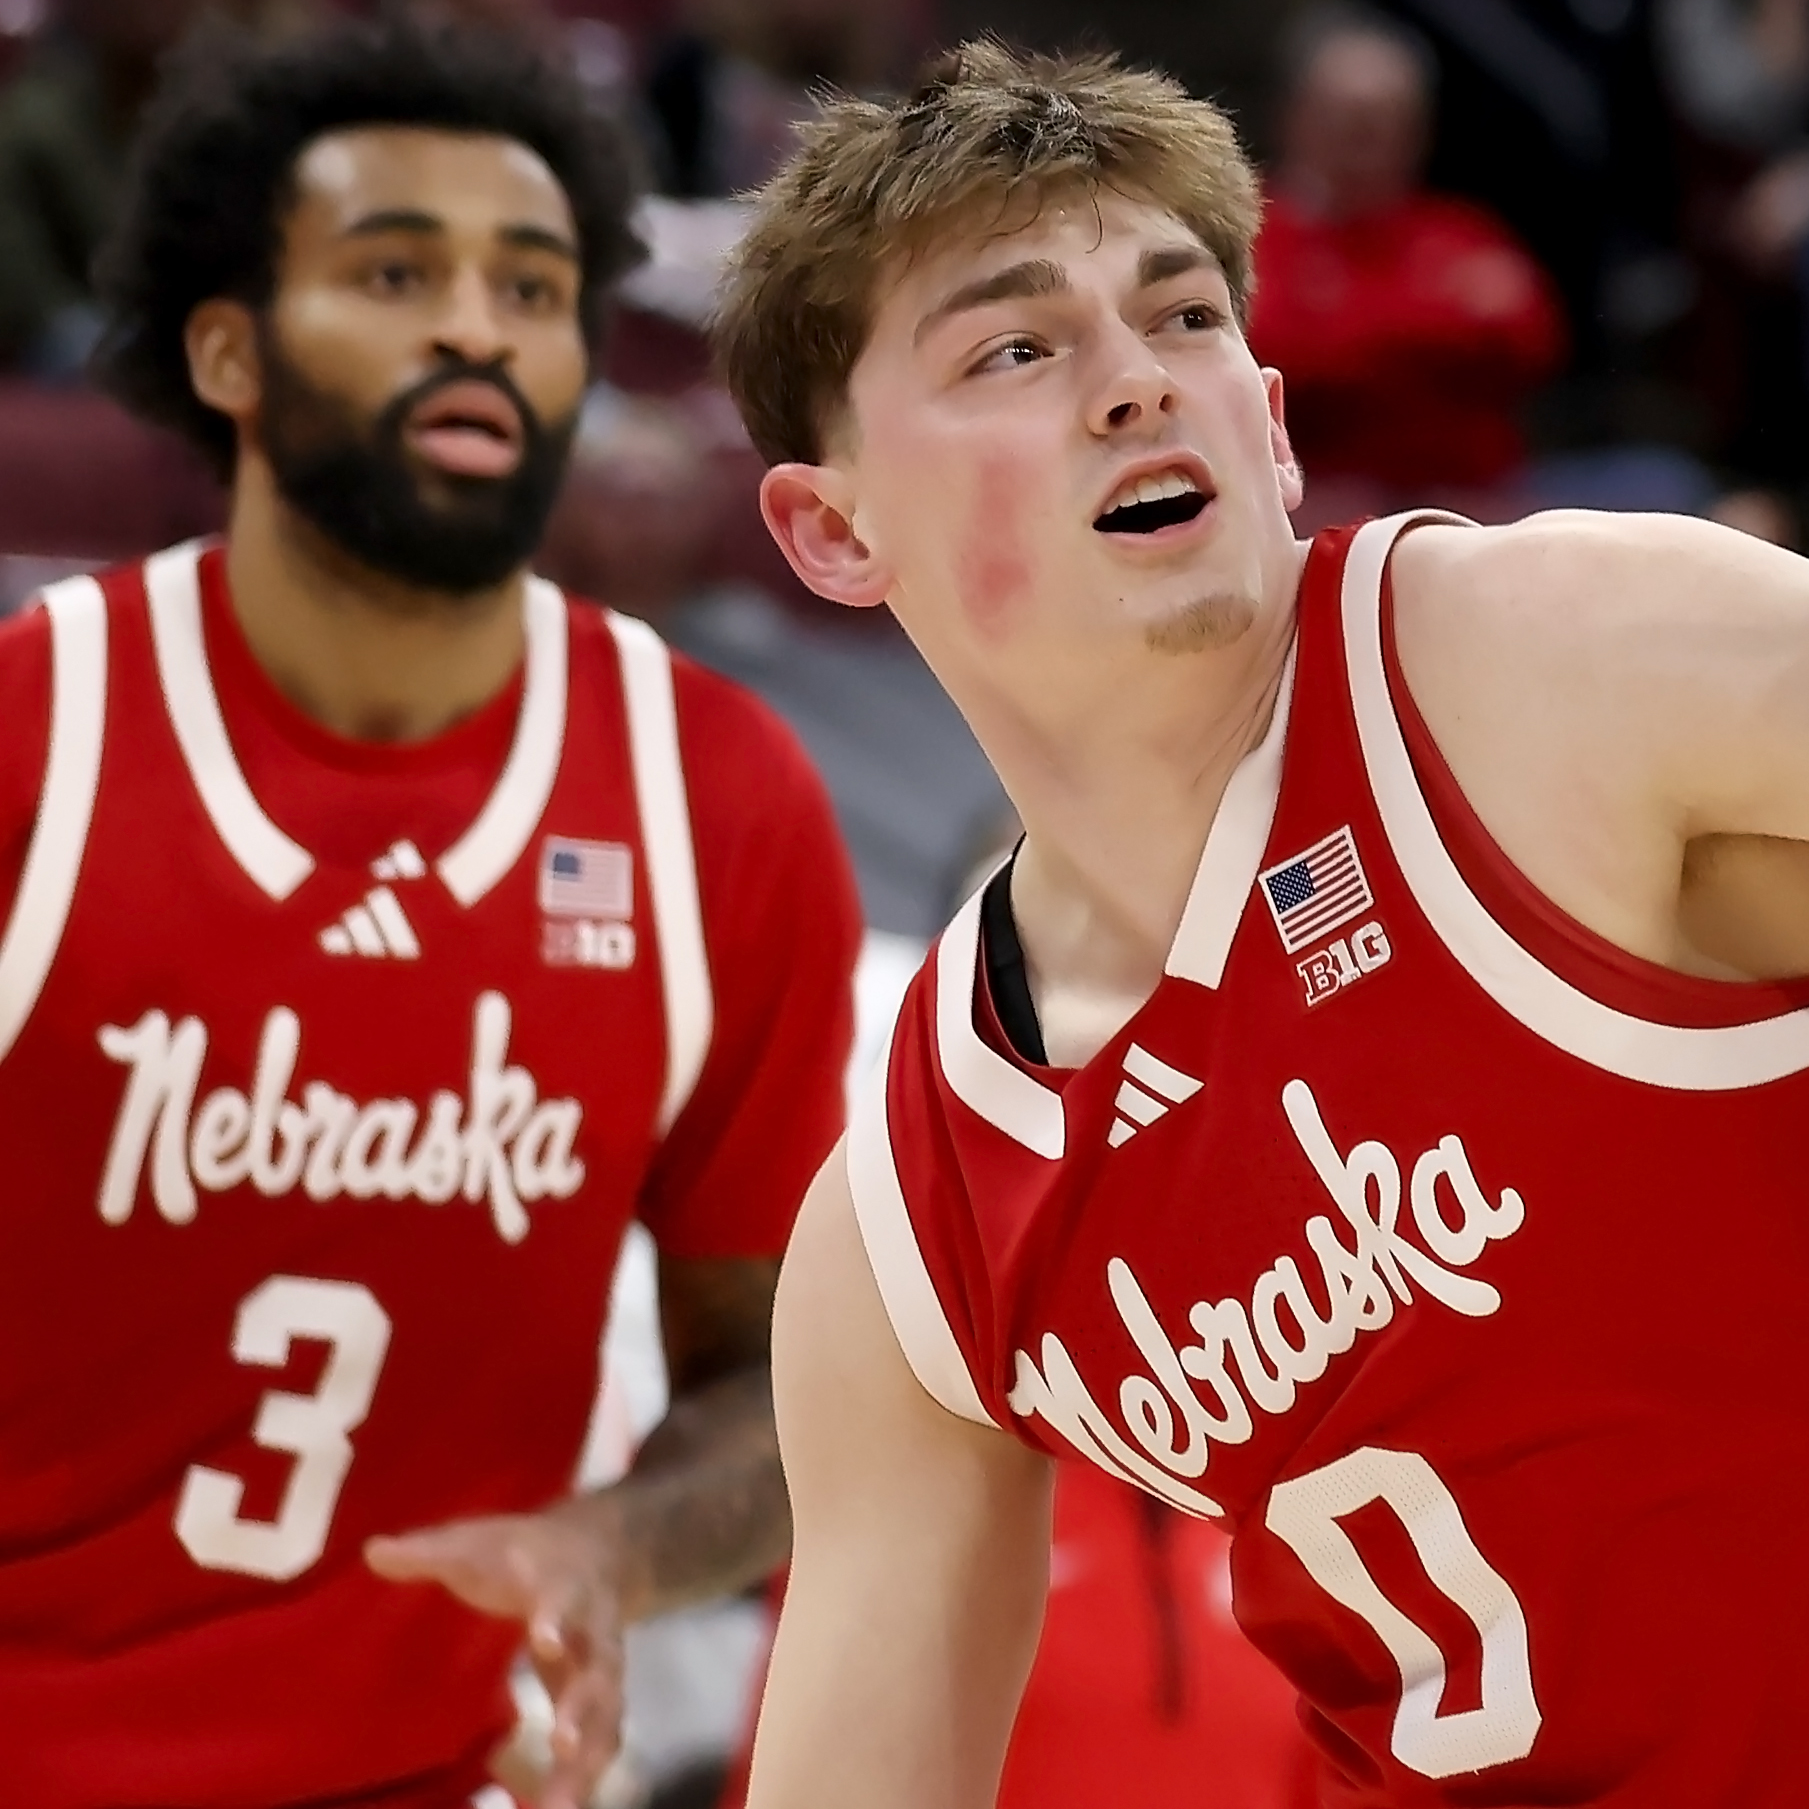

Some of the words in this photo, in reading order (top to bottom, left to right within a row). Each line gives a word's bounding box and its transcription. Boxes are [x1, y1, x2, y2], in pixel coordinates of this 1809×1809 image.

[96, 990, 585, 1245] Nebraska
[173, 1273, 392, 1581] 3
[1006, 1078, 1526, 1521] Nebraska
[1265, 1445, 1543, 1780] 0
